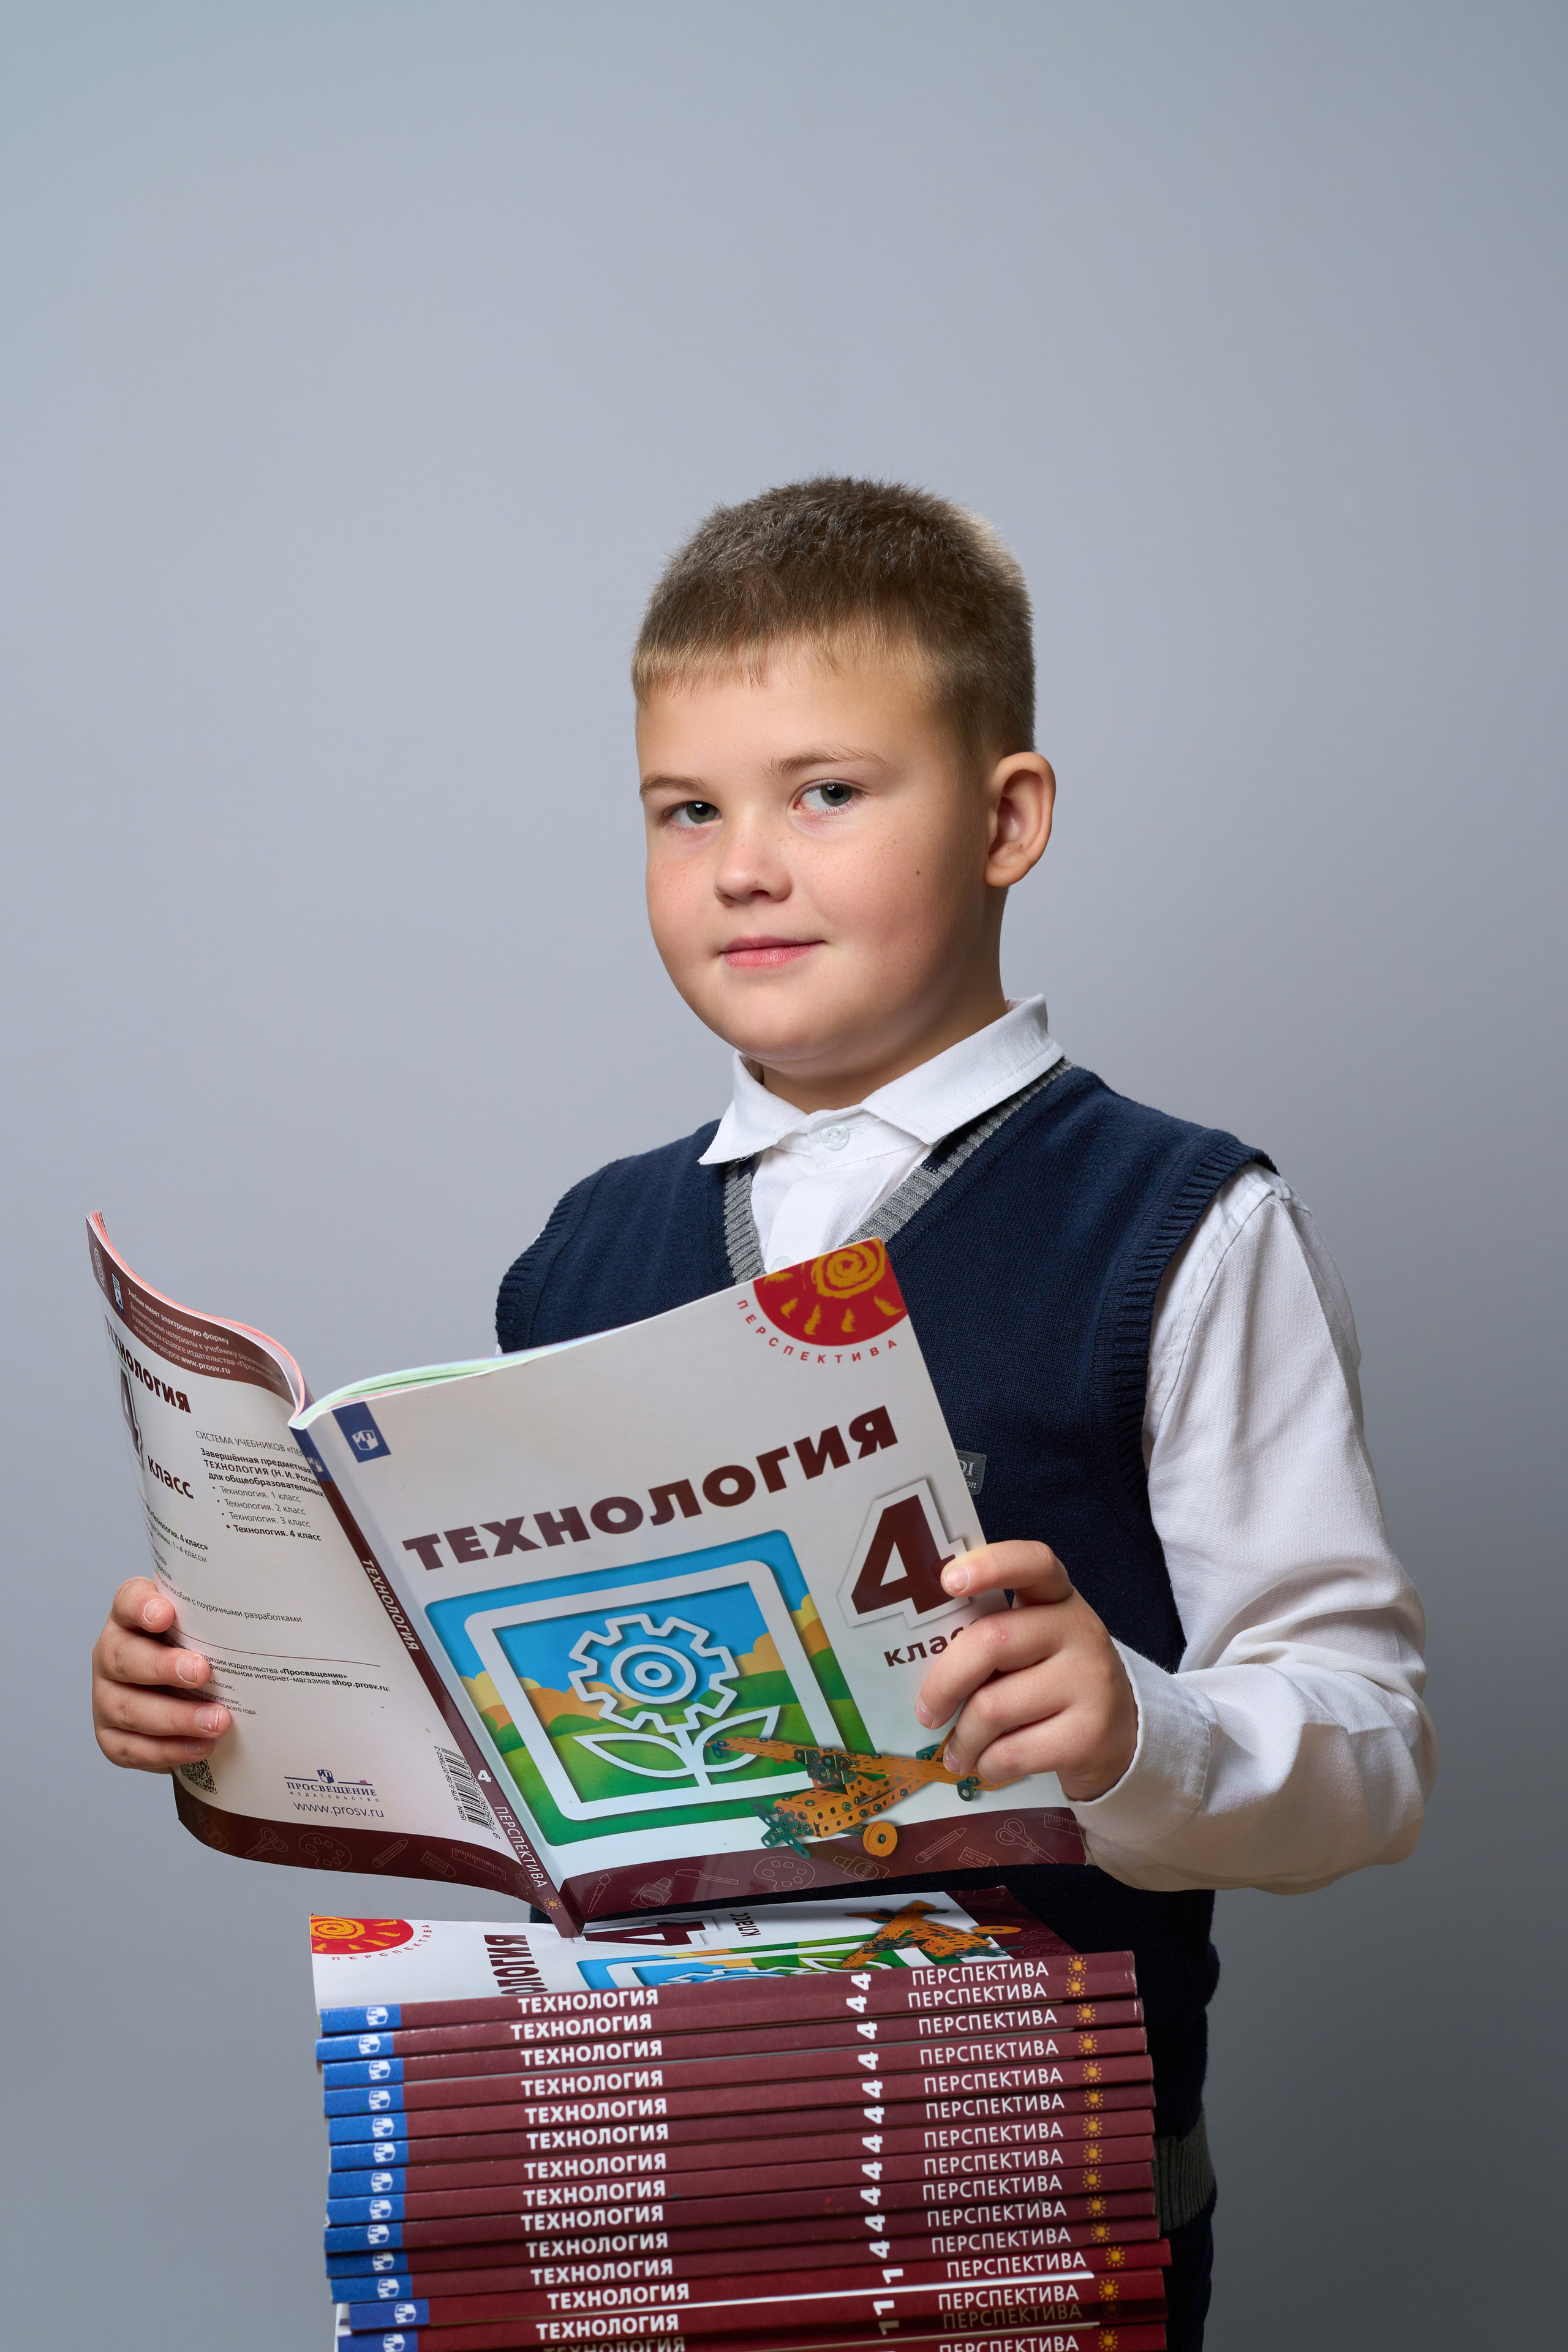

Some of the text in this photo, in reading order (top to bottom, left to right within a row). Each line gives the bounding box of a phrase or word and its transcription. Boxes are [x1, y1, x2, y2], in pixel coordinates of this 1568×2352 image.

[135, 1316, 162, 1341] электронном
[162, 1336, 186, 1355] каталоге
[187, 1349, 236, 1366] издательства
[145, 1302, 160, 1317] имеет
[161, 1314, 202, 1336] электронную
[203, 1332, 229, 1345] форму
[166, 1329, 198, 1348] материалы
[203, 1344, 238, 1358] учебнику
[737, 1299, 897, 1364] ПЕРСПЕКТИВА
[140, 1329, 180, 1360] интернет-ресурсе
[181, 1357, 231, 1374] www.prosv.ru
[195, 1431, 234, 1446] СИСТЕМА
[234, 1438, 285, 1452] УЧЕБНИКОВ
[200, 1447, 312, 1474] Завершённая предметная
[148, 1455, 194, 1499] класс
[204, 1459, 270, 1476] ТЕХНОЛОГИЯ
[271, 1469, 284, 1479] (Н.
[209, 1472, 325, 1498] для общеобразовательных
[402, 1406, 898, 1570] ТЕХНОЛОГИЯ
[220, 1485, 270, 1499] Технология.
[278, 1493, 301, 1502] класс
[224, 1498, 274, 1512] Технология.
[283, 1506, 306, 1515] класс
[228, 1511, 311, 1528] Технология. 3 класс
[233, 1524, 288, 1537] Технология.
[297, 1532, 322, 1542] класс
[184, 1548, 208, 1563] классы
[185, 1537, 208, 1551] класс»
[851, 1494, 956, 1615] 4
[169, 1585, 191, 1604] пособие
[197, 1600, 243, 1617] поурочными
[244, 1611, 303, 1623] разработками
[362, 1559, 420, 1650] ТЕХНОЛОГИЯ
[884, 1619, 978, 1667] клас
[200, 1653, 347, 1679] дукции издательства «Просвещение»
[209, 1662, 391, 1692] фициальном интернет-магазине shop.prosv.ru:
[286, 1782, 377, 1796] ПРОСВЕЩЕНИЕ
[290, 1791, 380, 1803] ИЗДАТЕЛЬСТВО
[477, 1770, 492, 1782] 4
[293, 1802, 385, 1818] www.prosv.ru
[457, 1805, 467, 1822] ISBN
[495, 1807, 547, 1888] ПЕРСПЕКТИВА
[963, 1853, 987, 1866] ЛАСТИК
[642, 1893, 661, 1904] КЛЕЙ
[332, 1924, 432, 1961] ПЕРСПЕКТИВА
[729, 1912, 761, 1937] класс
[483, 1934, 549, 1996] ОЛОГИЯ
[517, 1961, 1049, 2014] ТЕХНОЛОГИЯ 4 ПЕРСПЕКТИВА
[510, 1982, 1047, 2040] ТЕХНОЛОГИЯ 4 ПЕРСПЕКТИВА
[520, 2008, 1058, 2067] ТЕХНОЛОГИЯ 4 ПЕРСПЕКТИВА
[521, 2039, 1059, 2097] ТЕХНОЛОГИЯ 4 ПЕРСПЕКТИВА
[524, 2067, 1063, 2124] ТЕХНОЛОГИЯ 4 ПЕРСПЕКТИВА
[526, 2094, 1065, 2150] ТЕХНОЛОГИЯ 4 ПЕРСПЕКТИВА
[524, 2122, 1064, 2179] ТЕХНОЛОГИЯ 4 ПЕРСПЕКТИВА
[522, 2149, 1063, 2207] ТЕХНОЛОГИЯ 4 ПЕРСПЕКТИВА
[521, 2174, 1062, 2231] ТЕХНОЛОГИЯ 4 ПЕРСПЕКТИВА
[526, 2201, 1066, 2258] ТЕХНОЛОГИЯ 4 ПЕРСПЕКТИВА
[530, 2227, 1071, 2285] ТЕХНОЛОГИЯ 4 ПЕРСПЕКТИВА
[547, 2252, 1087, 2310] ТЕХНОЛОГИЯ 1 ПЕРСПЕКТИВА
[535, 2285, 1079, 2340] ТЕХНОЛОГИЯ 1 ПЕРСПЕКТИВА
[543, 2335, 686, 2352] НОЛОГИЯ
[943, 2304, 1082, 2329] ПЕРСПЕКТИВА
